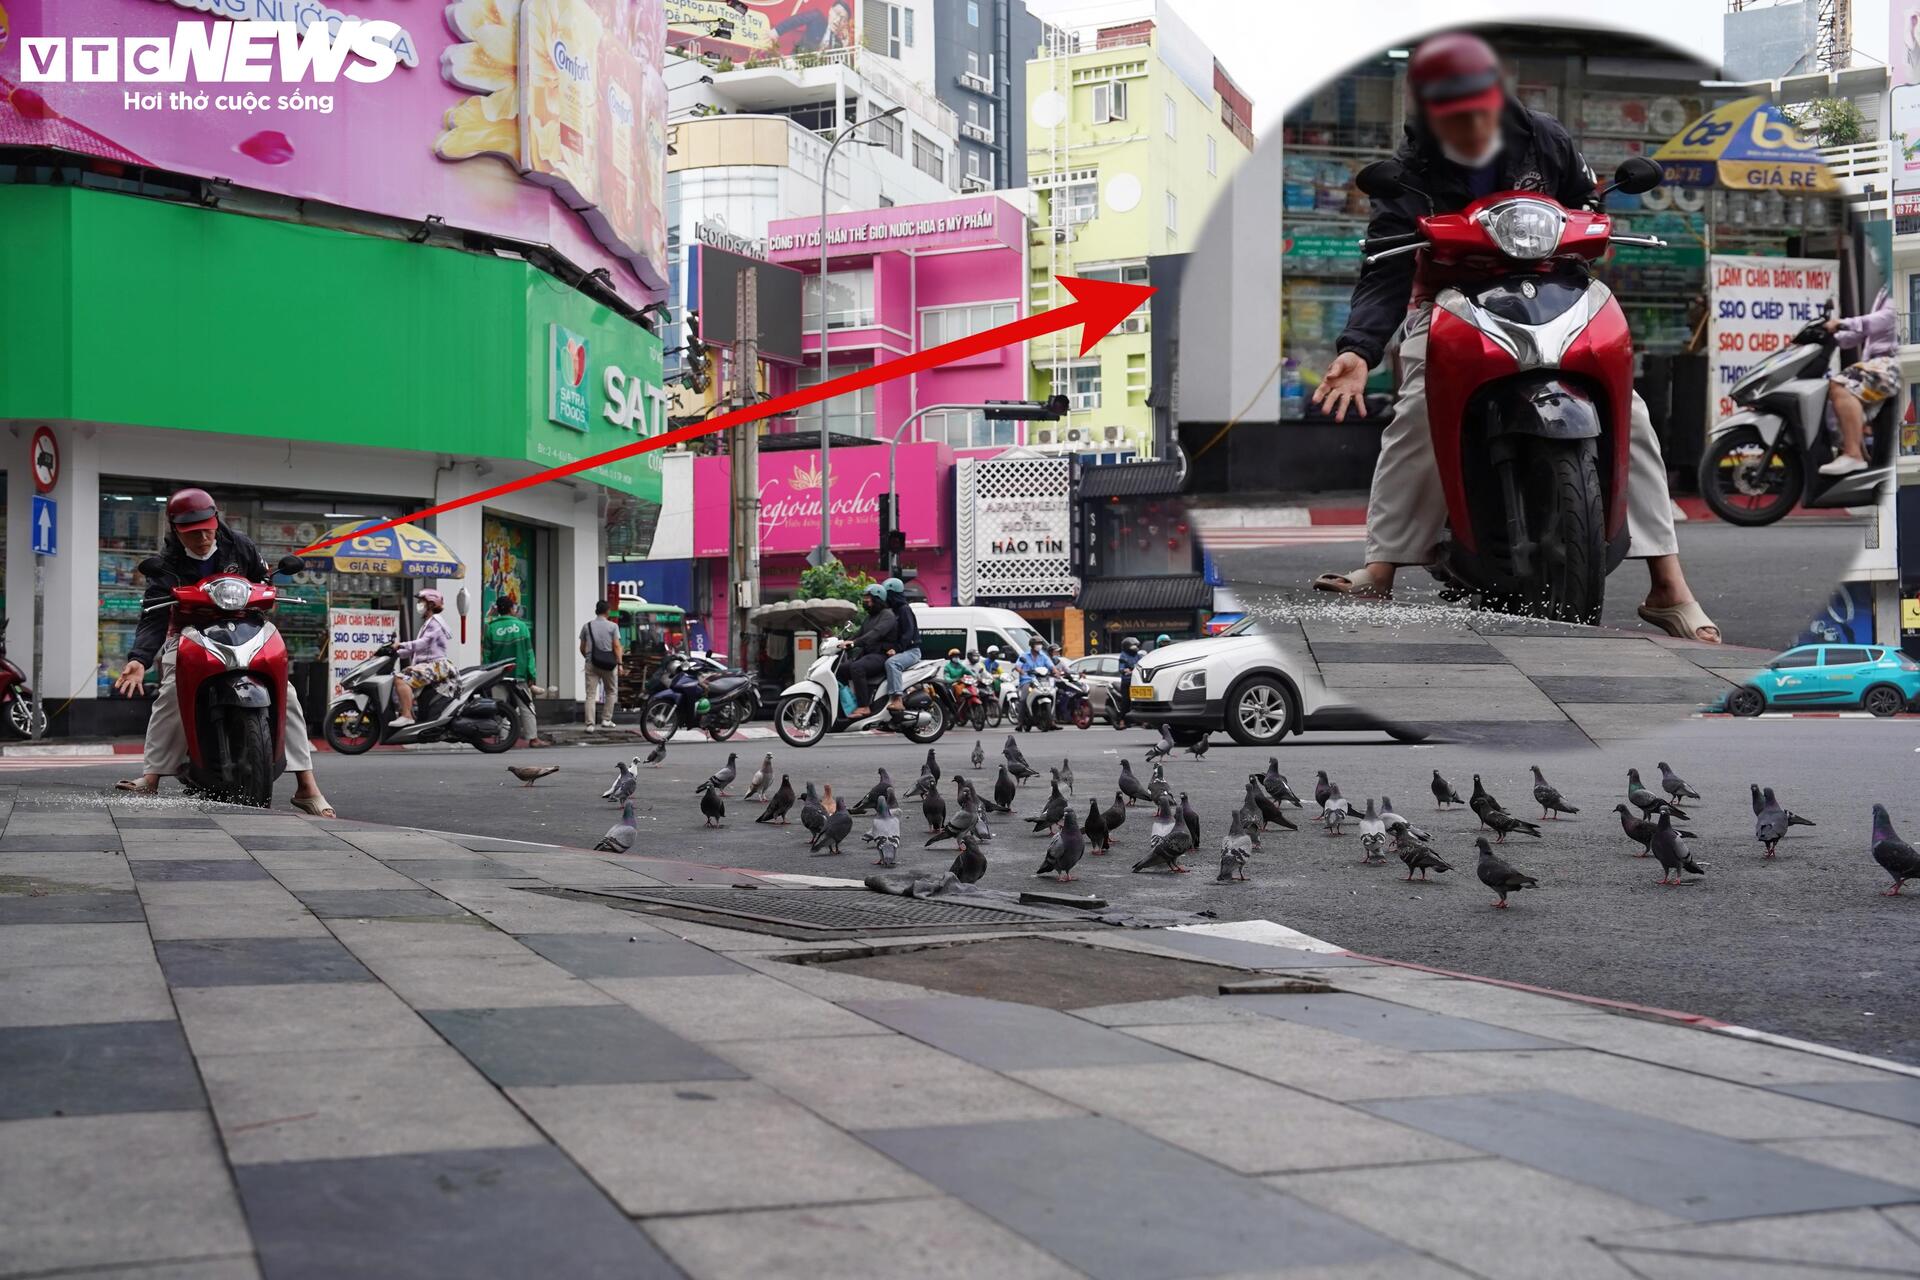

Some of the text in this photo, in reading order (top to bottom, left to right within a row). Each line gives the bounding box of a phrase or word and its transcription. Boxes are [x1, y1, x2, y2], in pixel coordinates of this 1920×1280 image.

[554, 41, 590, 81] Comfort
[1747, 166, 1817, 187] GIÁ RẺ
[769, 233, 793, 251] CÔNG
[795, 232, 808, 248] TY
[916, 219, 937, 235] HOA
[938, 218, 945, 233] &
[1719, 300, 1746, 319] SAO
[1719, 333, 1744, 352] SAO
[560, 387, 586, 410] SATRA
[560, 402, 586, 423] FOODS
[349, 560, 372, 571] GIÁ
[335, 632, 349, 643] SAO
[496, 623, 520, 636] Grab
[335, 651, 348, 661] SAO
